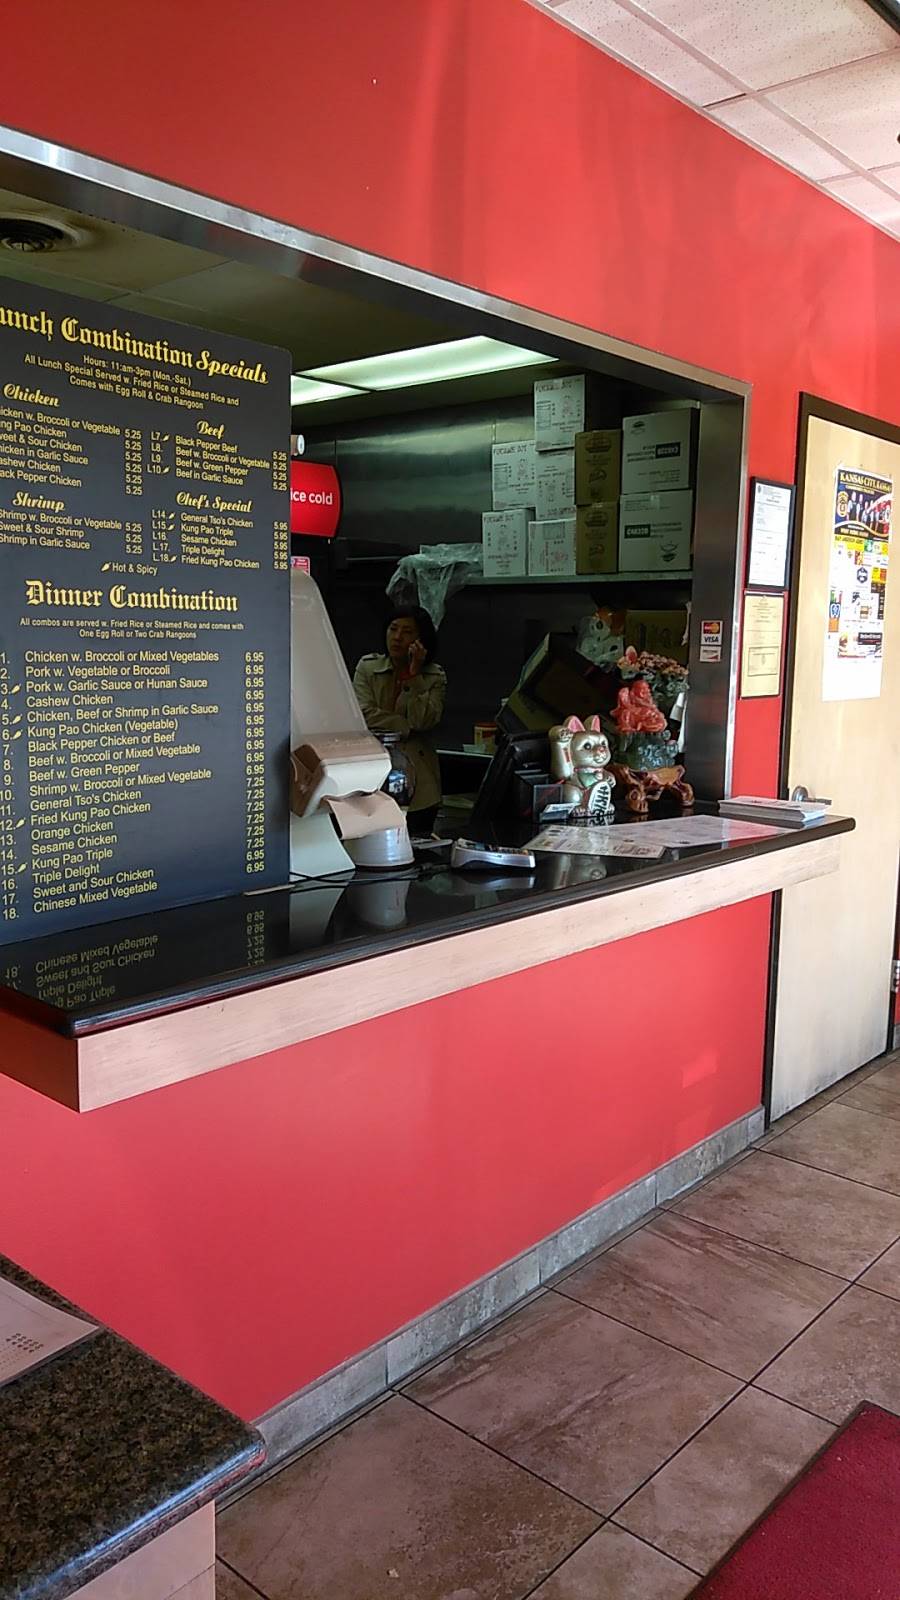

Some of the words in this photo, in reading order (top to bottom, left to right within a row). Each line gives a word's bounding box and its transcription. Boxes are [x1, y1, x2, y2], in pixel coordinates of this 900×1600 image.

[0, 307, 54, 341] unch
[61, 316, 193, 368] Combination
[196, 350, 268, 384] Specials
[84, 355, 108, 367] Hours:
[4, 384, 60, 406] Chicken
[69, 375, 96, 388] Comes
[99, 382, 113, 392] with
[116, 384, 130, 397] Egg
[132, 388, 146, 398] Roll
[148, 391, 153, 399] &
[155, 392, 172, 403] Crab
[174, 396, 204, 409] Rangoon
[197, 420, 225, 439] Beef
[175, 436, 195, 446] Black
[196, 439, 220, 452] Pepper
[222, 443, 238, 453] Beef
[273, 451, 287, 461] 5.25
[12, 491, 65, 513] Shrimp
[176, 492, 210, 509] Chef's
[212, 496, 252, 512] Special
[308, 491, 333, 505] cold
[181, 513, 208, 523] General
[209, 516, 226, 525] Tso's
[228, 518, 253, 528] Chicken
[274, 522, 288, 530] 5.95
[113, 563, 126, 572] Hot
[129, 564, 134, 572] &
[137, 564, 158, 576] Spicy
[25, 580, 103, 606] Dinner
[110, 584, 238, 611] Combination
[0, 652, 10, 664] 1.
[25, 650, 68, 662] Chicken
[71, 653, 82, 662] w.
[85, 650, 124, 662] Broccoli
[127, 653, 137, 661] or
[140, 651, 168, 661] Mixed
[170, 651, 219, 664] Vegetables
[245, 652, 264, 662] 6.95
[0, 669, 10, 679] 2.
[26, 666, 51, 677] Pork
[54, 668, 64, 677] w.
[67, 665, 118, 679] Vegetable
[120, 668, 131, 676] or
[133, 665, 170, 675] Broccoli
[245, 665, 264, 674] 6.95
[1, 684, 11, 694] 3.
[26, 681, 52, 692] Pork
[54, 683, 65, 692] w.
[68, 680, 99, 691] Garlic
[101, 680, 132, 690] Sauce
[147, 679, 177, 689] Hunan
[180, 678, 208, 688] Sauce
[245, 677, 264, 687] 6.95
[1, 699, 12, 709] 4.
[26, 696, 69, 707] Cashew
[73, 695, 113, 706] Chicken
[245, 690, 264, 700] 6.95
[2, 714, 12, 725] 5.
[27, 710, 73, 722] Chicken,
[76, 708, 100, 720] Beef
[102, 710, 112, 718] or
[115, 707, 149, 719] Shrimp
[152, 706, 160, 716] in
[162, 705, 189, 716] Garlic
[191, 705, 219, 714] Sauce
[246, 702, 264, 712] 6.95
[2, 729, 13, 740] 6.
[28, 726, 55, 738] Kung
[59, 724, 79, 735] Pao
[82, 722, 122, 734] Chicken
[125, 718, 178, 734] (Vegetable)
[246, 715, 264, 725] 6.95
[3, 744, 13, 755] 7.
[28, 740, 58, 752] Black
[60, 739, 97, 751] Pepper
[100, 735, 139, 747] Chicken
[154, 732, 175, 743] Beef
[246, 727, 264, 737] 6.95
[4, 760, 14, 770] 8.
[29, 754, 54, 767] Beef
[56, 756, 67, 765] w.
[71, 750, 110, 764] Broccoli
[113, 752, 123, 760] or
[126, 748, 153, 759] Mixed
[155, 744, 200, 758] Vegetable
[246, 740, 264, 750] 6.95
[4, 775, 14, 785] 9.
[30, 769, 55, 781] Beef
[71, 767, 102, 778] Green
[105, 764, 140, 776] Pepper
[246, 752, 264, 762] 6.95
[29, 784, 67, 796] Shrimp
[70, 784, 80, 792] w.
[84, 777, 123, 791] Broccoli
[125, 778, 135, 786] or
[138, 773, 165, 785] Mixed
[167, 769, 212, 783] Vegetable
[246, 765, 264, 775] 6.95
[0, 805, 15, 816] 11.
[30, 796, 72, 811] General
[75, 794, 100, 806] Tso's
[102, 791, 142, 803] Chicken
[246, 777, 264, 787] 7.25
[0, 820, 16, 831] 12.
[31, 812, 58, 825] Fried
[61, 811, 88, 822] Kung
[90, 808, 110, 818] Pao
[112, 803, 151, 815] Chicken
[246, 789, 264, 800] 7.25
[0, 835, 16, 846] 13.
[31, 828, 71, 840] Orange
[73, 822, 113, 834] Chicken
[246, 801, 264, 812] 7.25
[1, 850, 16, 860] 14.
[32, 842, 74, 855] Sesame
[77, 836, 117, 848] Chicken
[246, 813, 264, 824] 7.25
[1, 865, 18, 875] 15.
[32, 858, 60, 869] Kung
[63, 854, 83, 864] Pao
[86, 849, 113, 862] Triple
[246, 825, 264, 836] 7.25
[2, 879, 18, 890] 16.
[33, 871, 62, 884] Triple
[64, 864, 100, 878] Delight
[246, 838, 264, 848] 7.25
[2, 894, 19, 905] 17.
[33, 883, 66, 898] Sweet
[68, 879, 87, 892] and
[90, 876, 114, 888] Sour
[116, 869, 154, 883] Chicken
[246, 849, 264, 861] 6.95
[3, 908, 19, 920] 18.
[34, 898, 76, 912] Chinese
[80, 890, 108, 904] Mixed
[111, 882, 158, 898] Vegetable
[247, 862, 264, 873] 6.95
